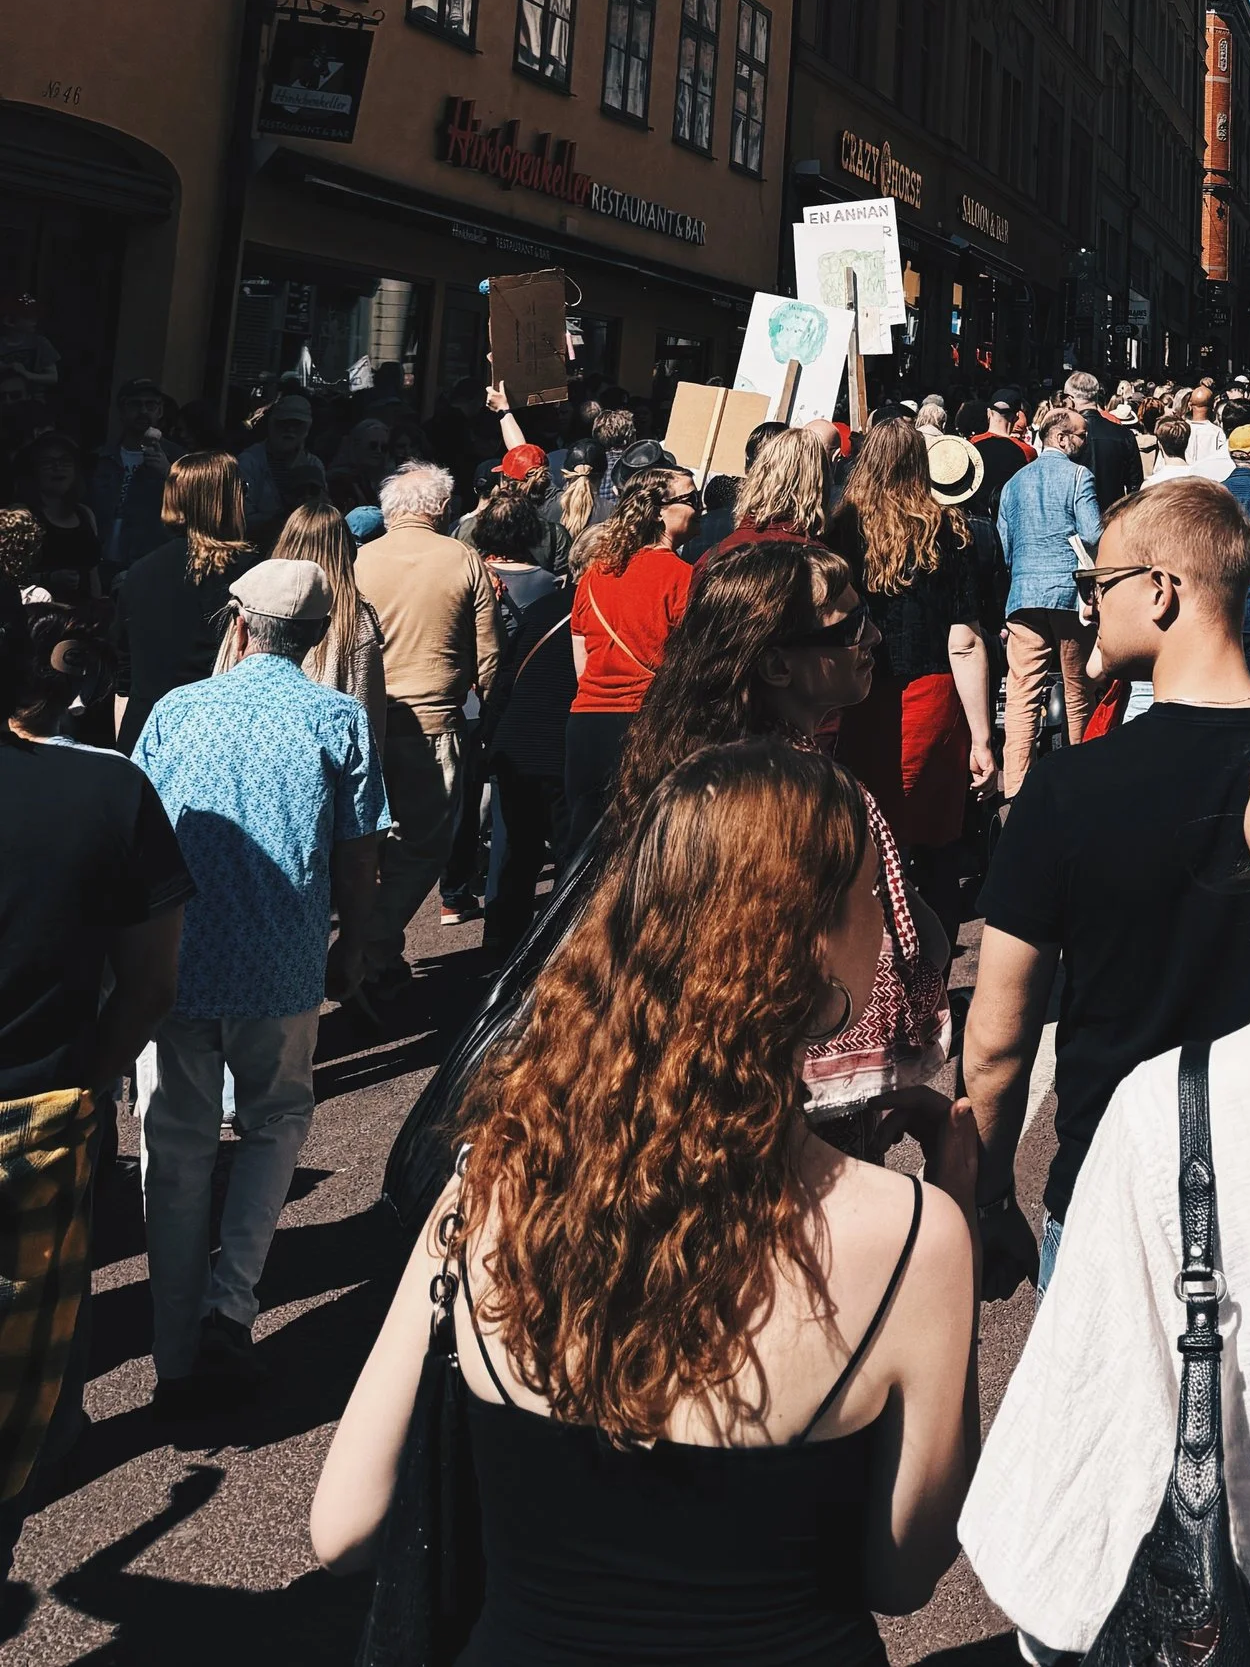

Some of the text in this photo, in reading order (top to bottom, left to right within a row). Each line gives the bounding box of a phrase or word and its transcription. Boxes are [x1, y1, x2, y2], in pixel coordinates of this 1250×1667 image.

[63, 86, 81, 105] 46
[841, 130, 922, 209] CRAZY HORSE
[809, 205, 889, 225] EN ANNAN
[962, 194, 990, 234] SALOON
[996, 215, 1009, 244] BAR
